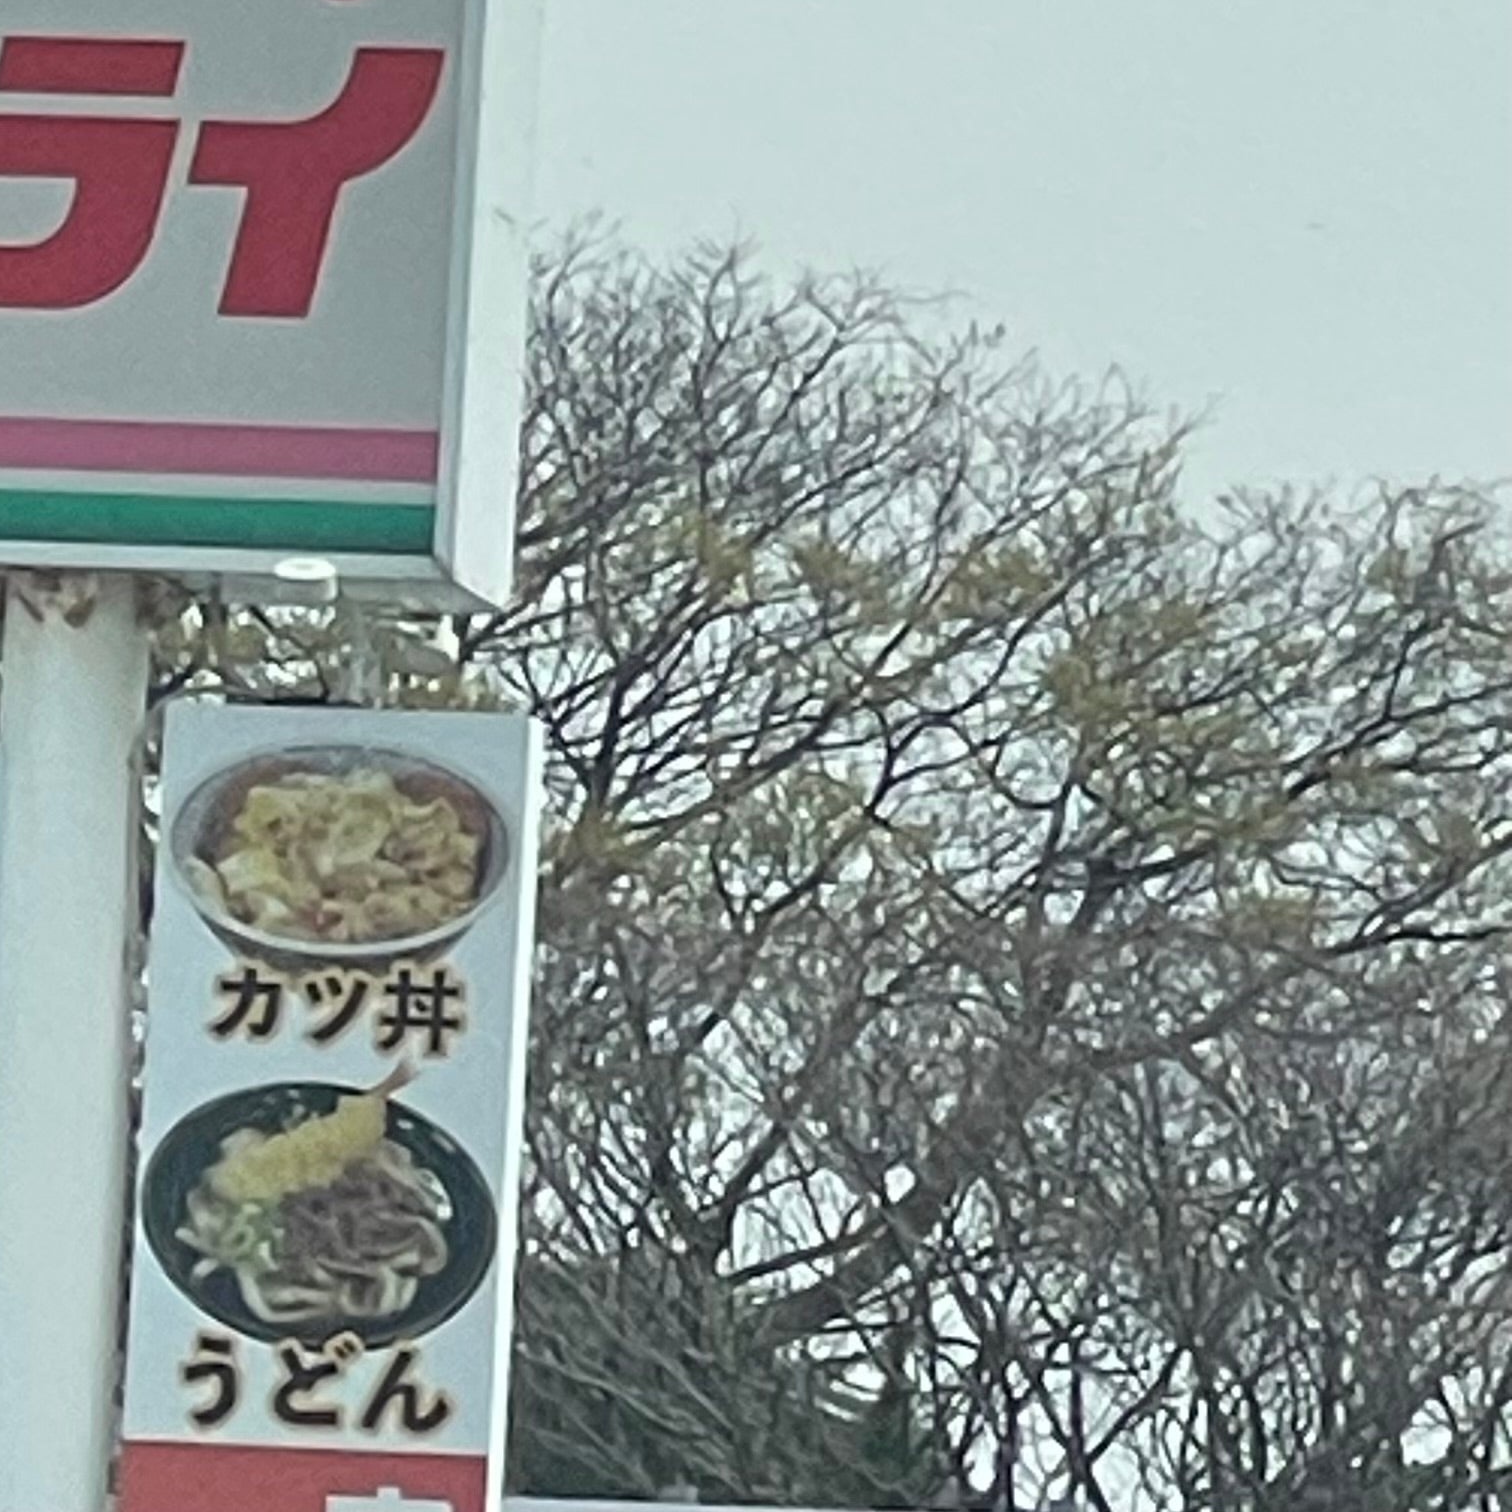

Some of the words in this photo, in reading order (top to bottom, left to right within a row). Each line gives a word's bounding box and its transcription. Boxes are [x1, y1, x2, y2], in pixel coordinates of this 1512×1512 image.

[209, 968, 462, 1052] カツ丼
[184, 1336, 451, 1433] うどん
